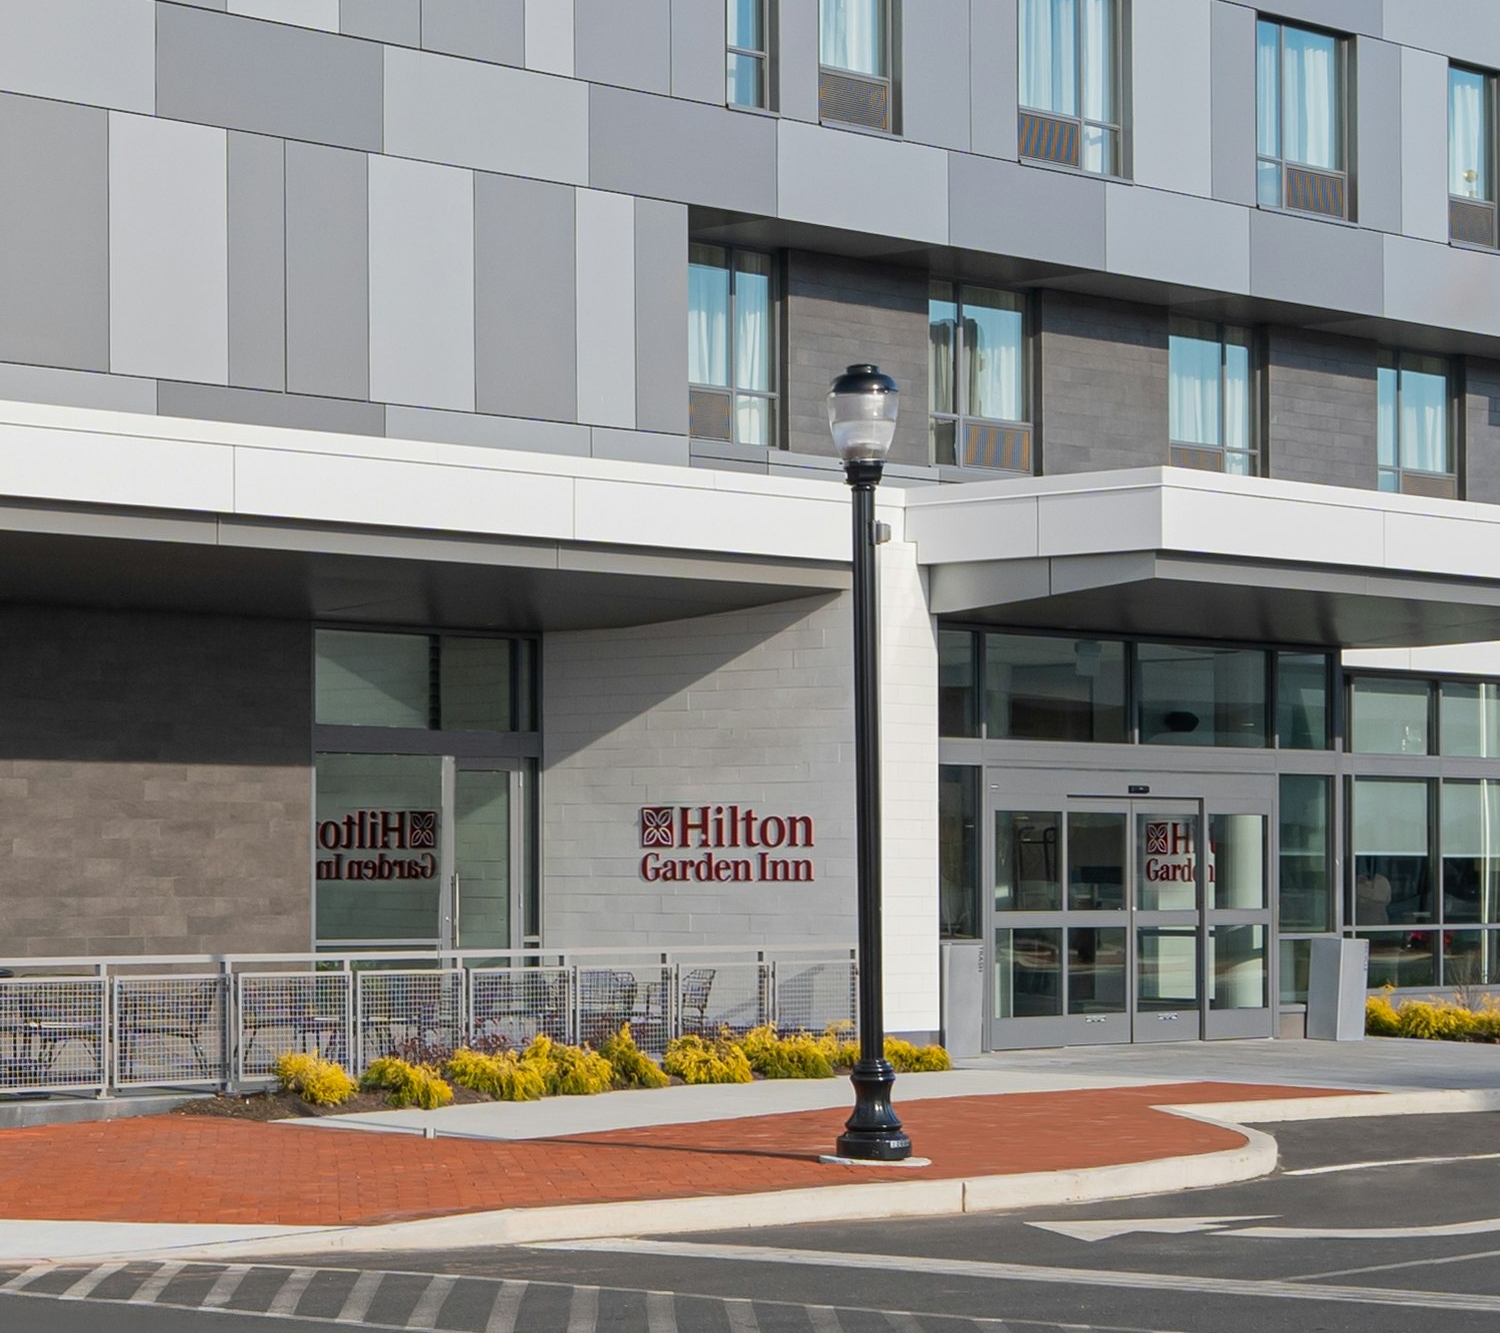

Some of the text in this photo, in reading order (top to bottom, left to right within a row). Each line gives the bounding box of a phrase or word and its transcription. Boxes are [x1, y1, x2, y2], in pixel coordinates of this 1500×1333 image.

[678, 806, 814, 848] Hilton
[641, 852, 814, 882] Garden Inn
